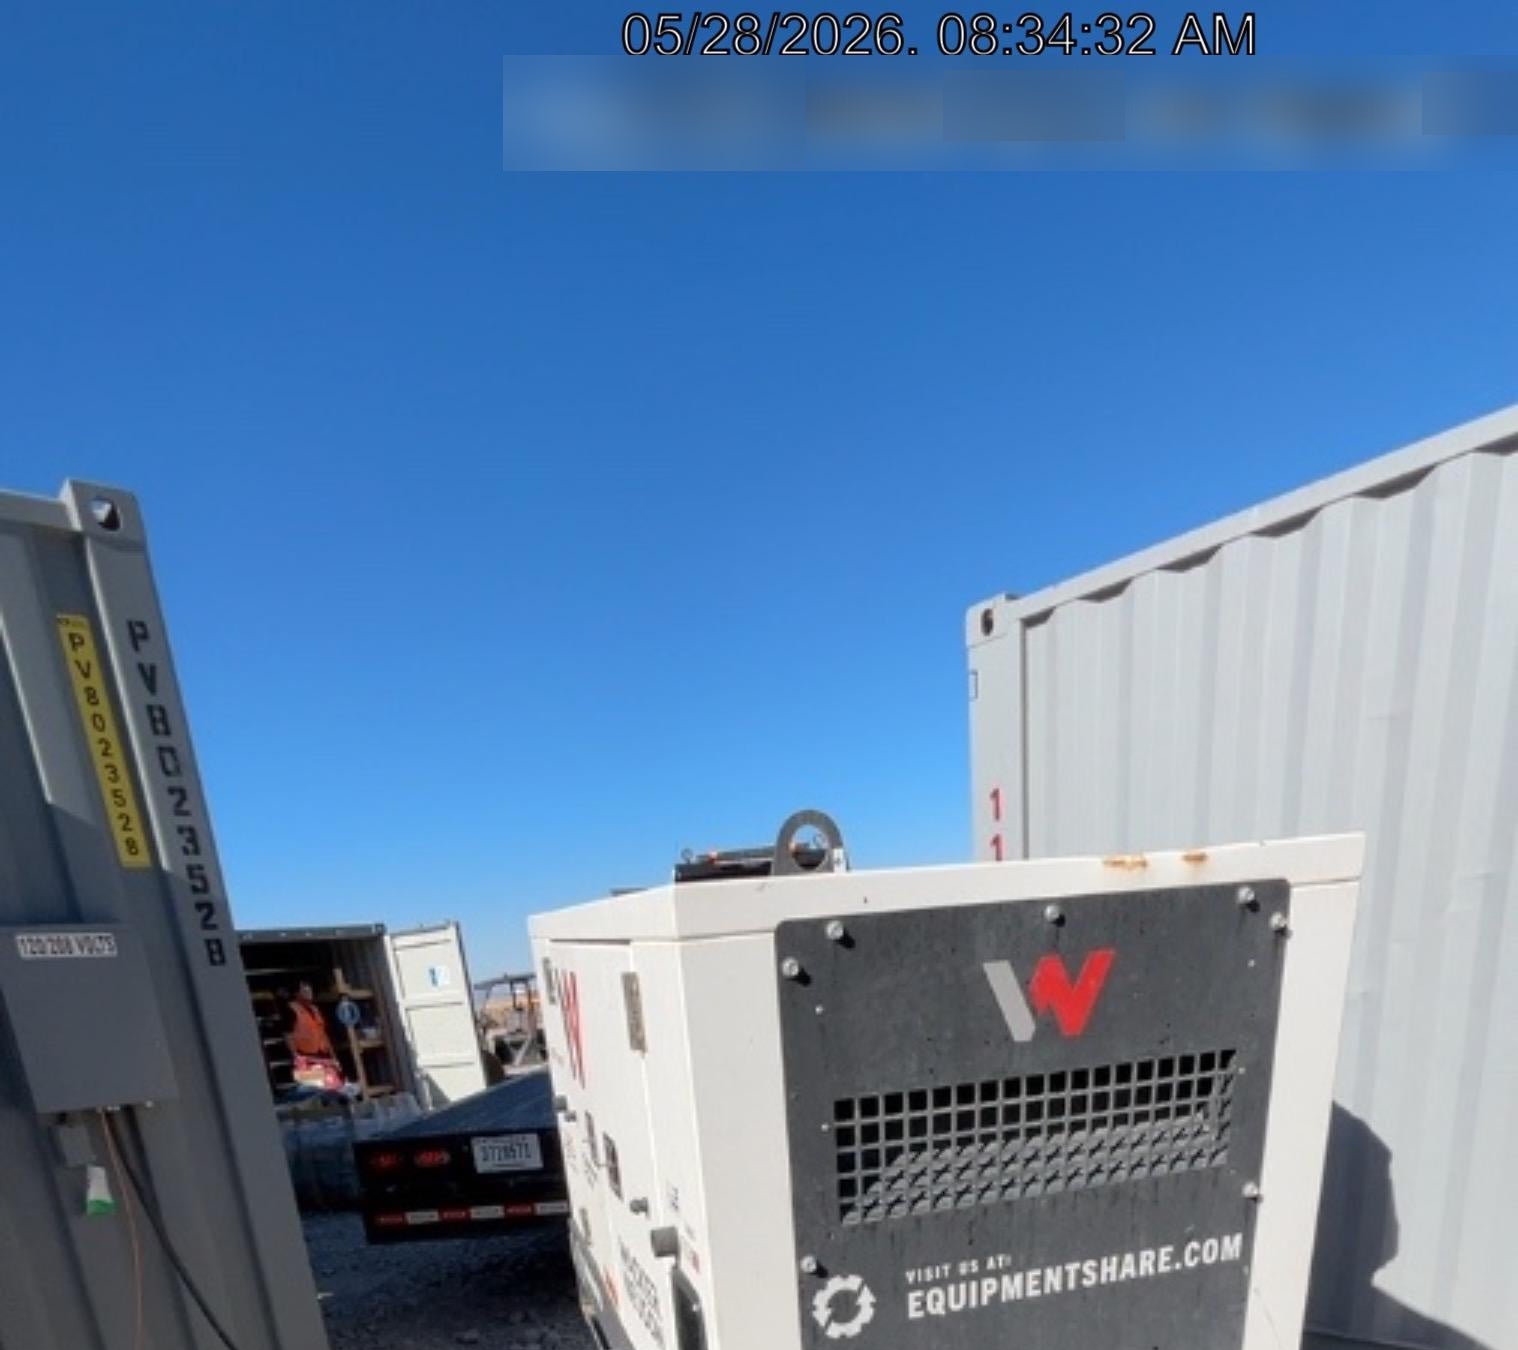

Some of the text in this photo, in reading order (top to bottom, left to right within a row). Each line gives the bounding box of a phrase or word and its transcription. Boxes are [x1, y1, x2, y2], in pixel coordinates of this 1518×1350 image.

[905, 1265, 953, 1285] VISIT
[959, 1259, 980, 1276] US
[907, 1232, 1243, 1320] EQUIPMENTSHARE.COM
